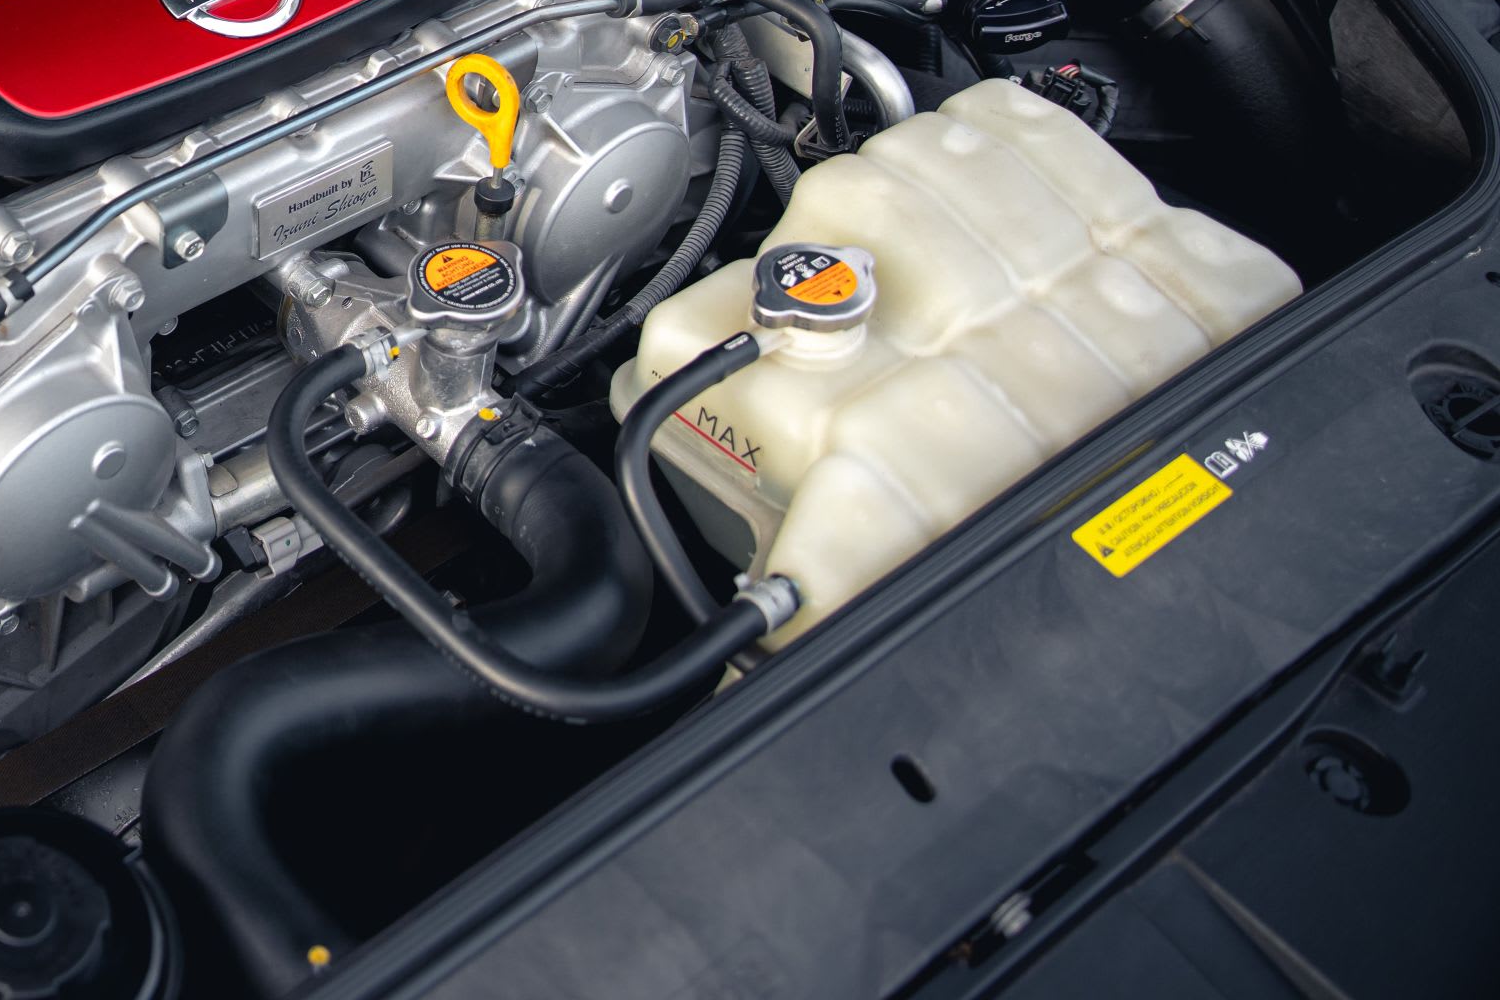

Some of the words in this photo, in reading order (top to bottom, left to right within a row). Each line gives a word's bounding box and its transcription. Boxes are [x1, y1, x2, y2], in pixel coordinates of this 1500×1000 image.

[288, 187, 339, 214] Handbuilt
[341, 178, 353, 192] by
[273, 212, 319, 245] Izumi
[324, 186, 378, 220] Shioya
[436, 256, 469, 273] WARNING
[442, 261, 475, 278] ACHTUNG
[697, 406, 761, 467] MAX
